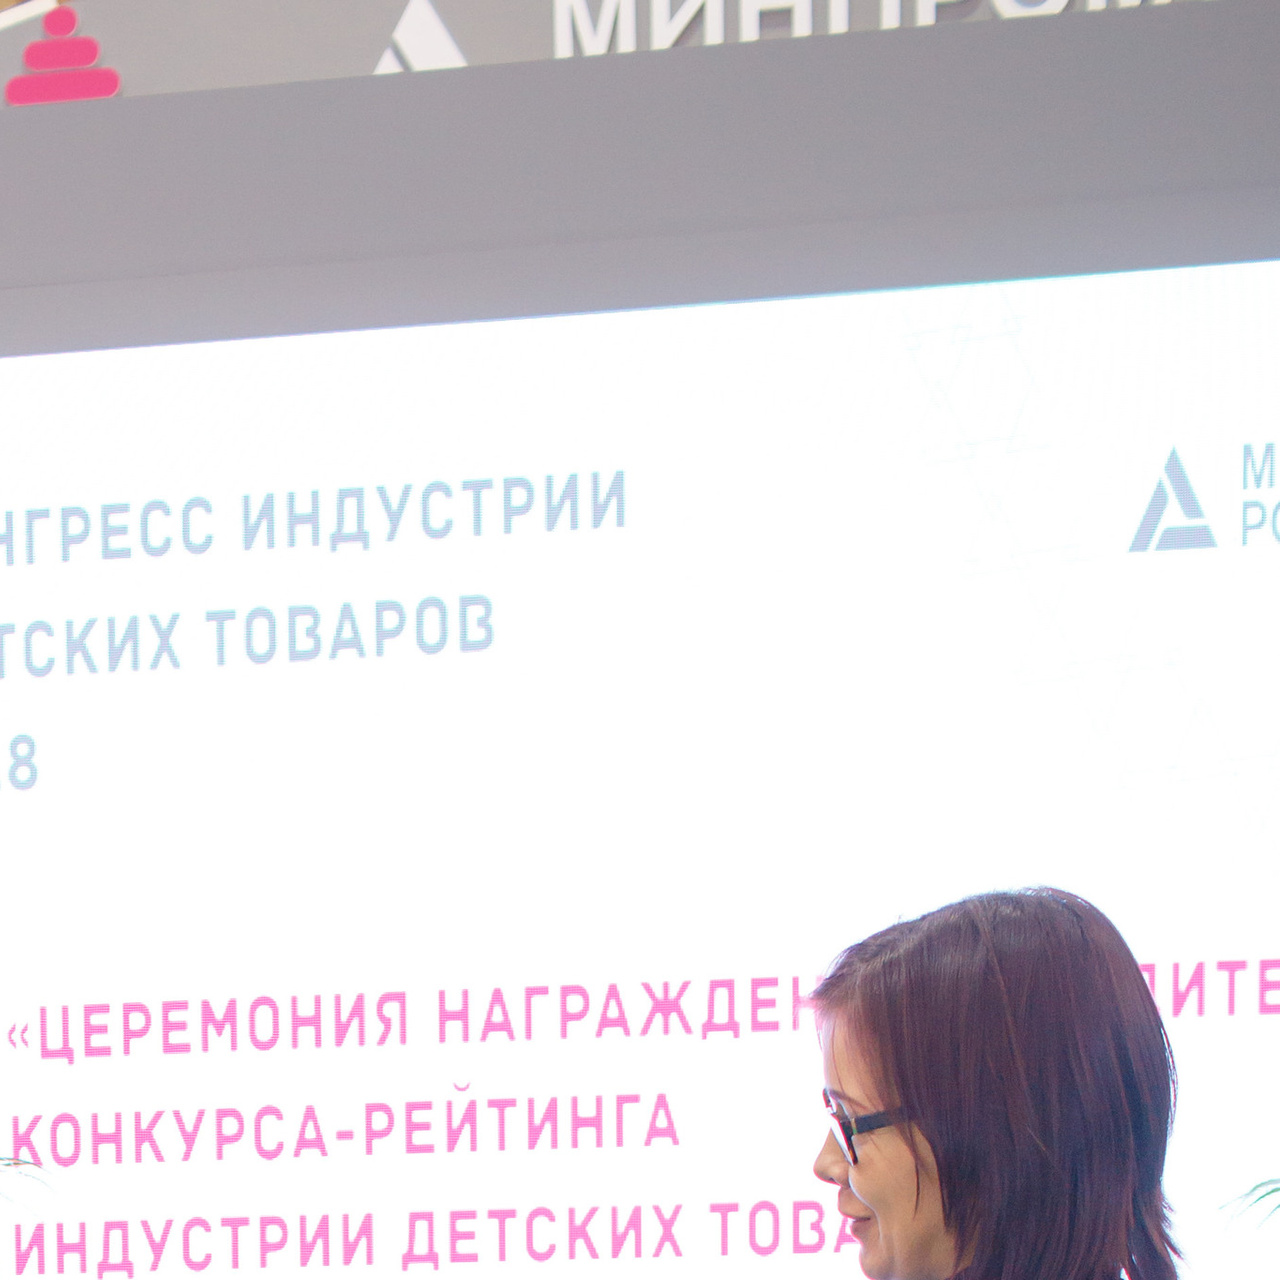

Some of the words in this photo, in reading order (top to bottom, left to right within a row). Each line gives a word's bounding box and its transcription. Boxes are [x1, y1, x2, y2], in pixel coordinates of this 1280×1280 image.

[241, 470, 627, 553] ИНДУСТРИИ
[204, 594, 495, 667] ТОВАРОВ
[7, 990, 408, 1066] «ЦЕРЕМОНИЯ
[11, 1083, 680, 1169] КОНКУРСА-РЕЙТИНГА
[14, 1213, 374, 1280] ИНДУСТРИИ
[401, 1204, 683, 1272] ДЕТСКИХ
